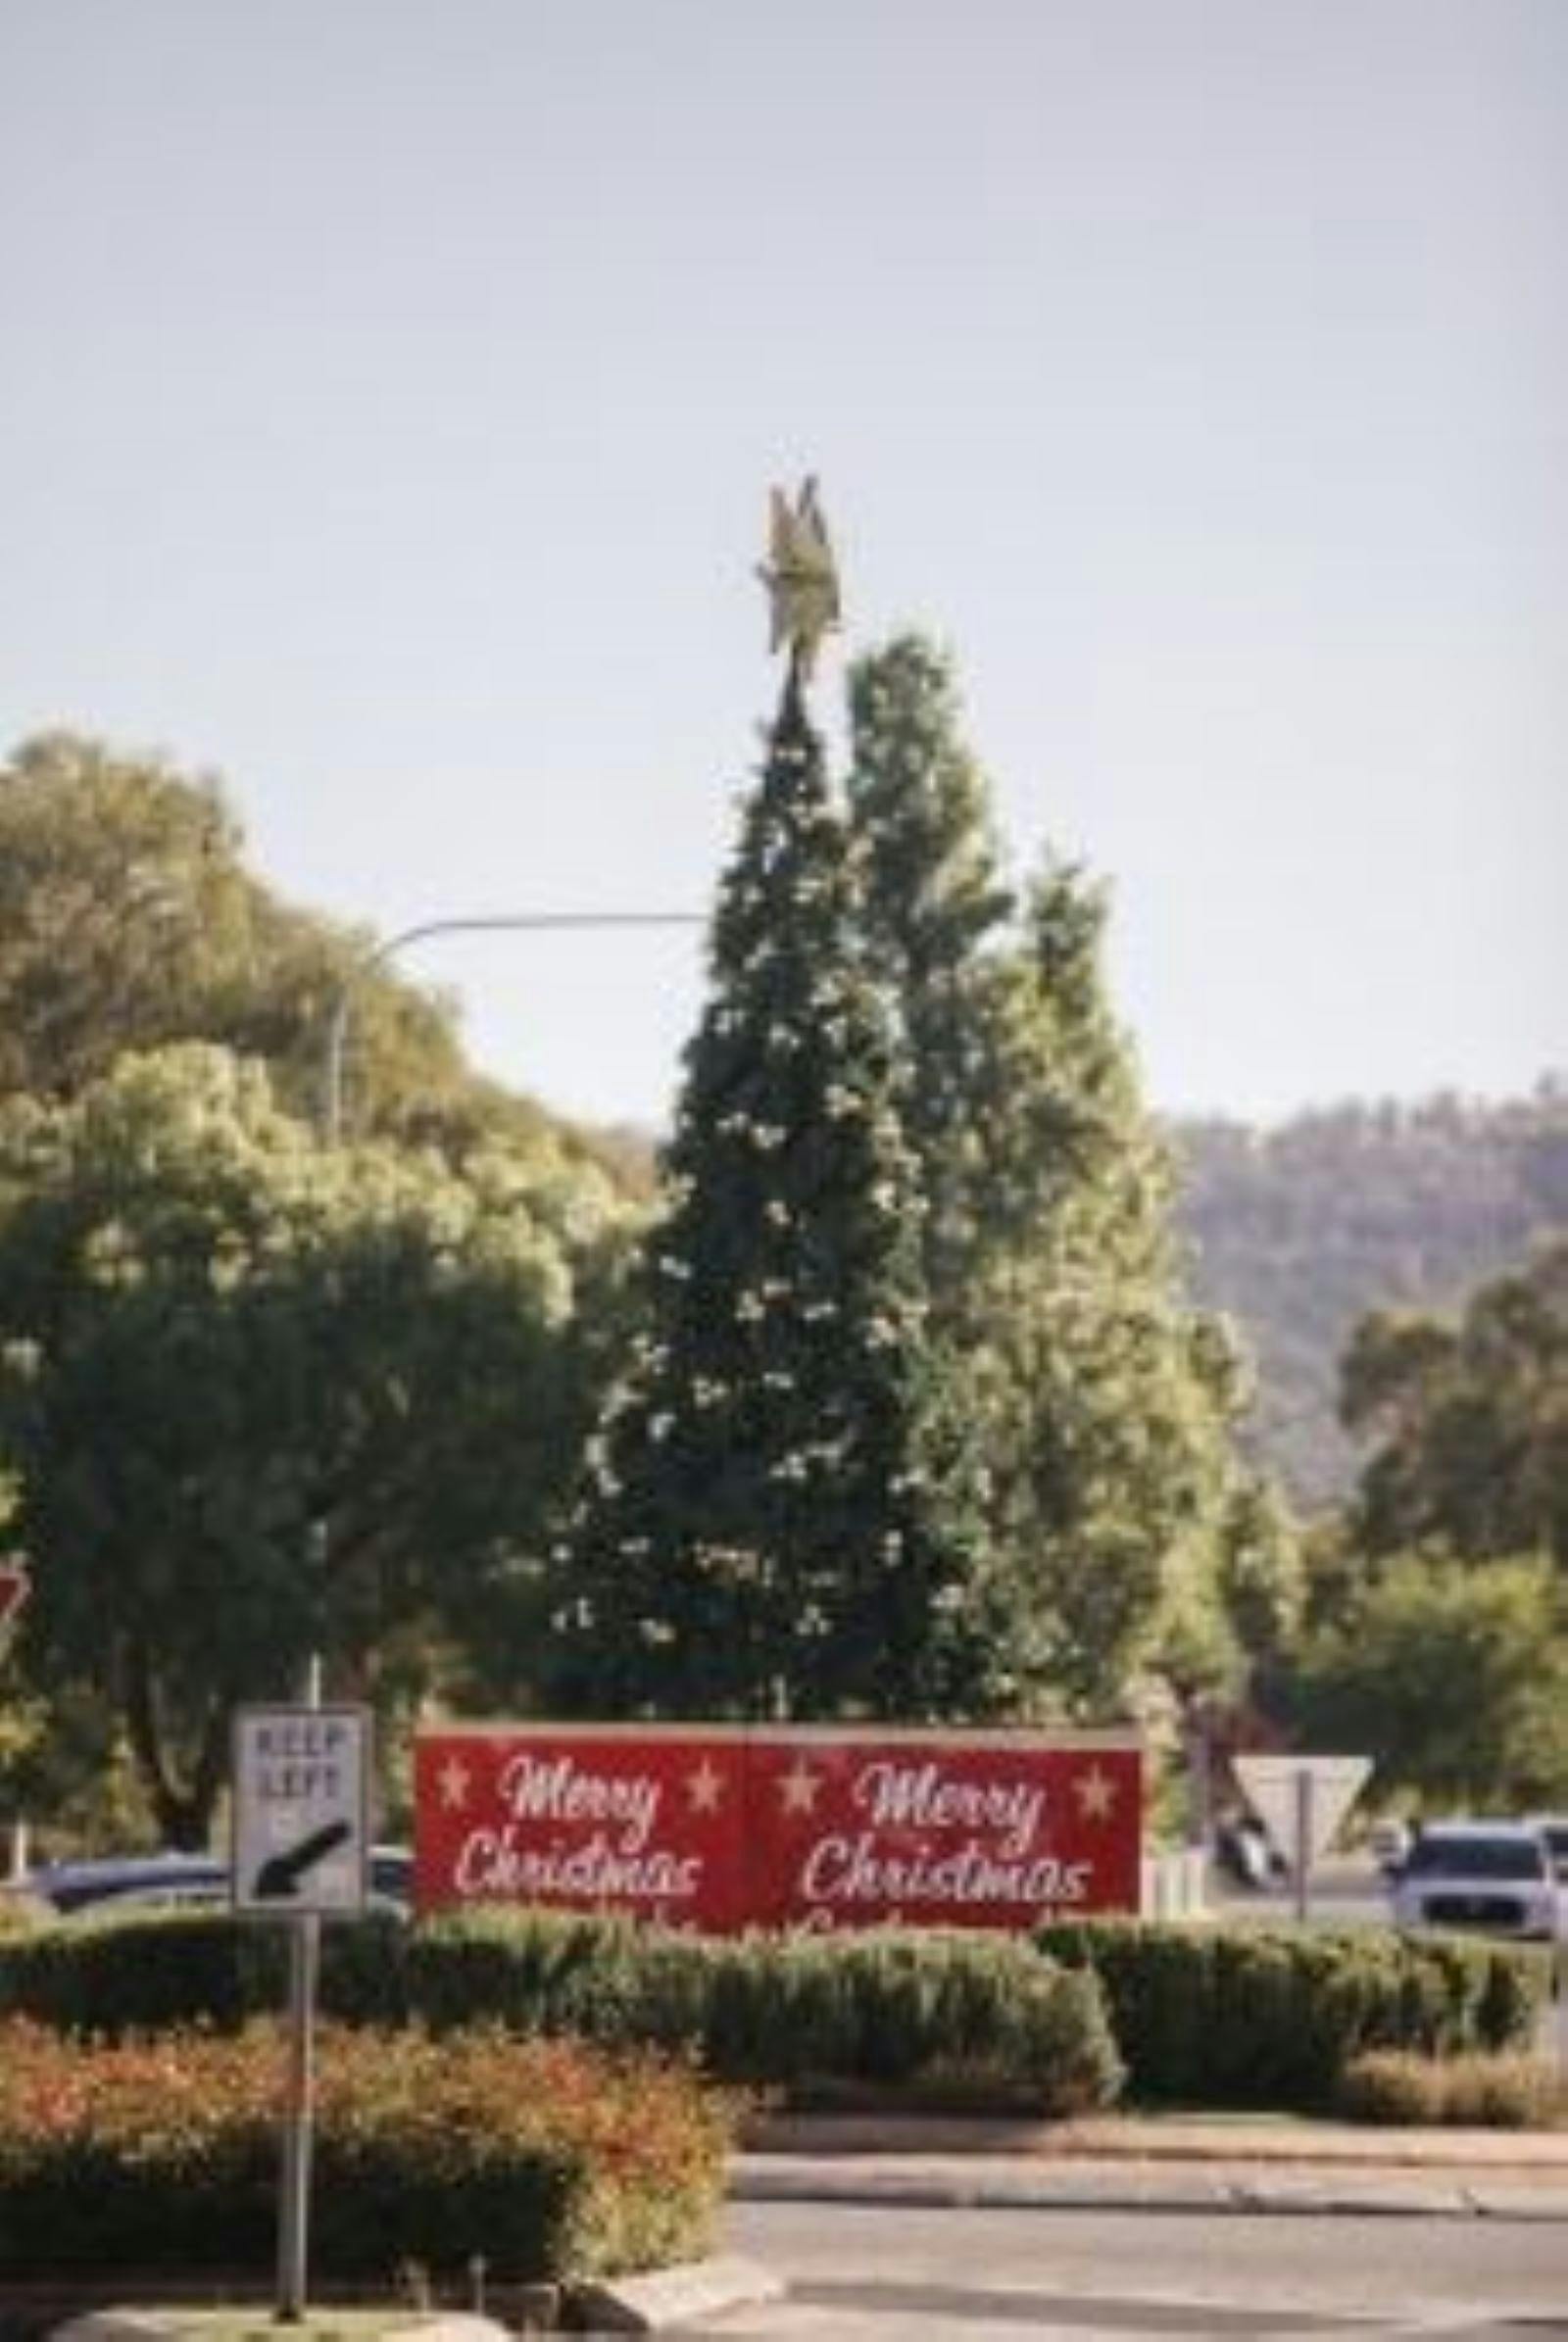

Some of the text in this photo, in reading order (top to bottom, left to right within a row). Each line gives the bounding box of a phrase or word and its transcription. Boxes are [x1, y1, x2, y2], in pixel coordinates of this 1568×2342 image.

[256, 1724, 347, 1757] KEEP
[257, 1765, 339, 1800] LEFT
[497, 1756, 662, 1855] Merry
[852, 1762, 1046, 1859] Merry
[454, 1823, 704, 1896] Christmas
[802, 1831, 1093, 1902] Christmas
